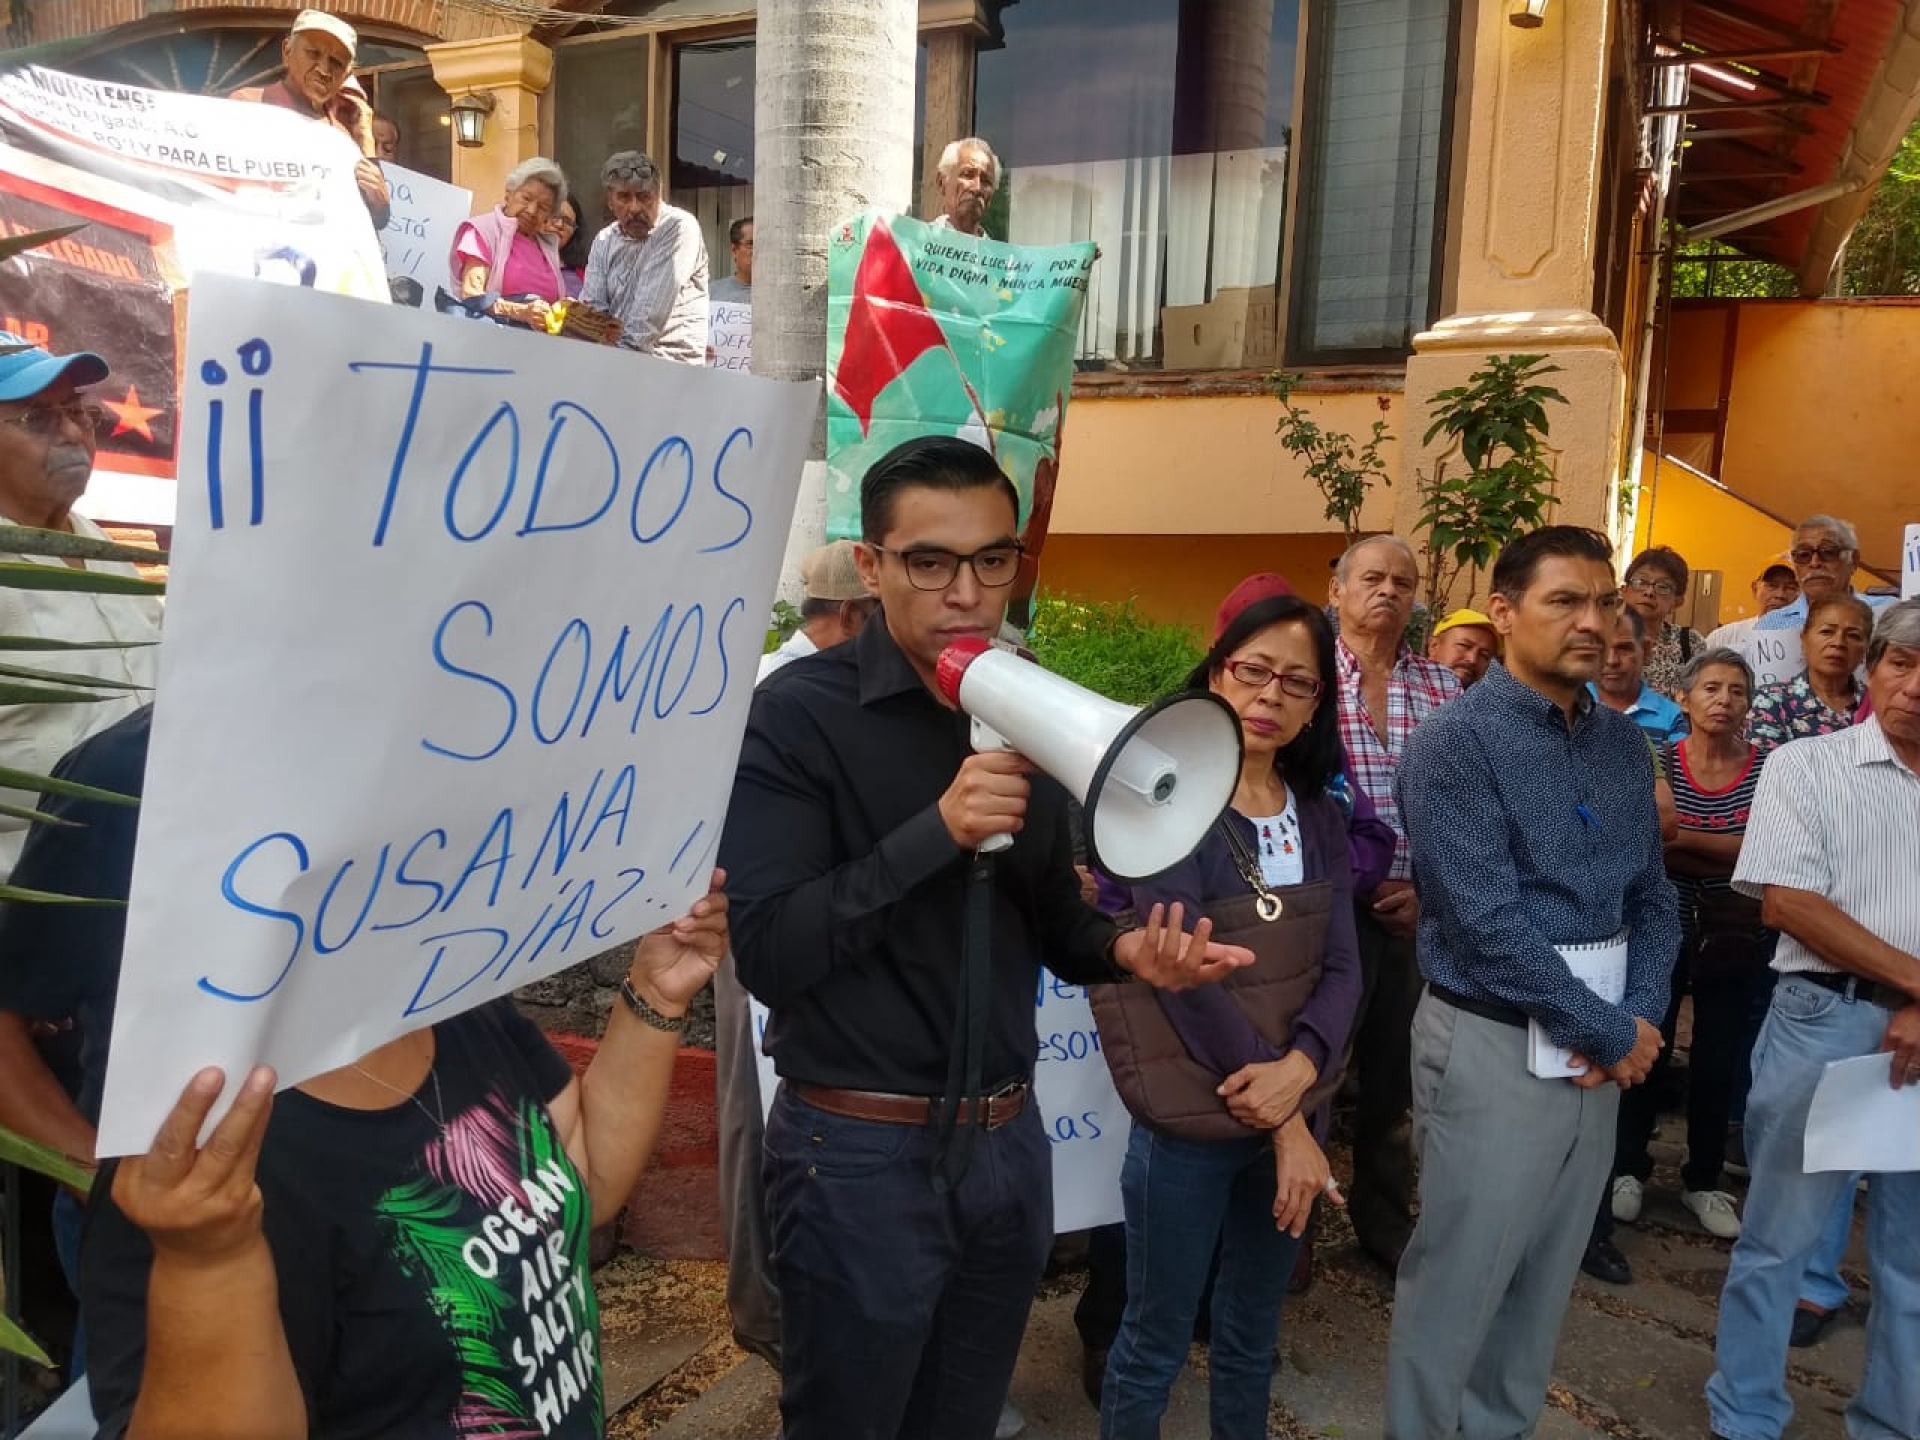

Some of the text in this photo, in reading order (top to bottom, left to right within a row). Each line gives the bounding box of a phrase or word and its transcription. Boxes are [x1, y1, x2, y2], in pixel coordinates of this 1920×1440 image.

[158, 145, 211, 169] PARA
[215, 155, 241, 175] EL
[915, 258, 945, 276] VIDA
[948, 267, 989, 286] DIGNA
[999, 275, 1046, 290] NUNCA
[923, 242, 978, 266] QUIENES
[1049, 258, 1077, 273] POR
[348, 341, 755, 553] TODOS
[422, 597, 746, 761] SOMOS
[199, 764, 637, 1002] SUSANA
[462, 1159, 576, 1279] OCEAN
[521, 1230, 570, 1314] AIR
[512, 1266, 587, 1386] SALTY
[533, 1330, 596, 1437] HAIR
